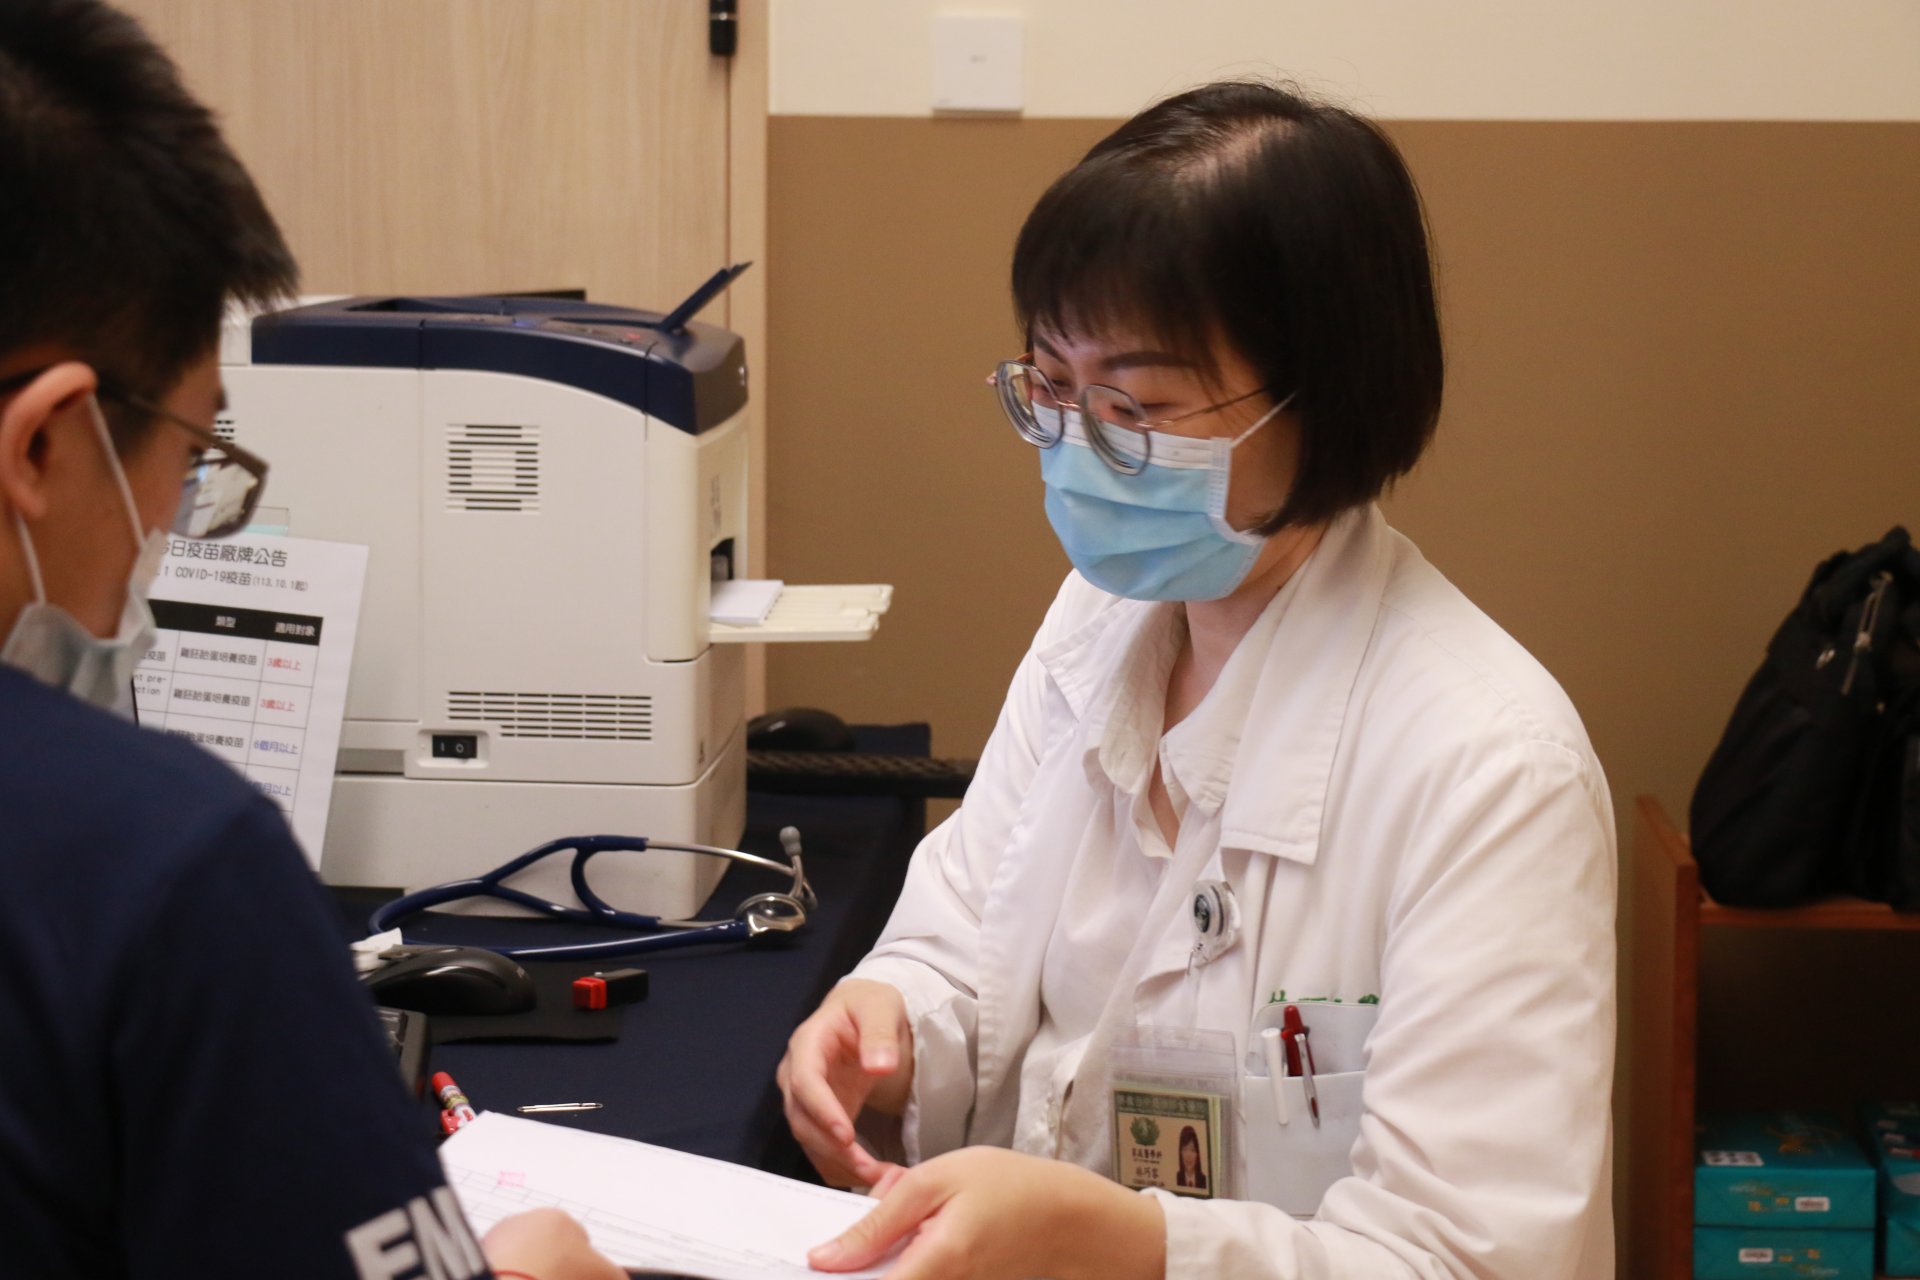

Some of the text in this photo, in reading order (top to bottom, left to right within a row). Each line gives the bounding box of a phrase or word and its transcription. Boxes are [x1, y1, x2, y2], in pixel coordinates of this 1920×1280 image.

[165, 539, 288, 568] 日疫苗廠牌公告
